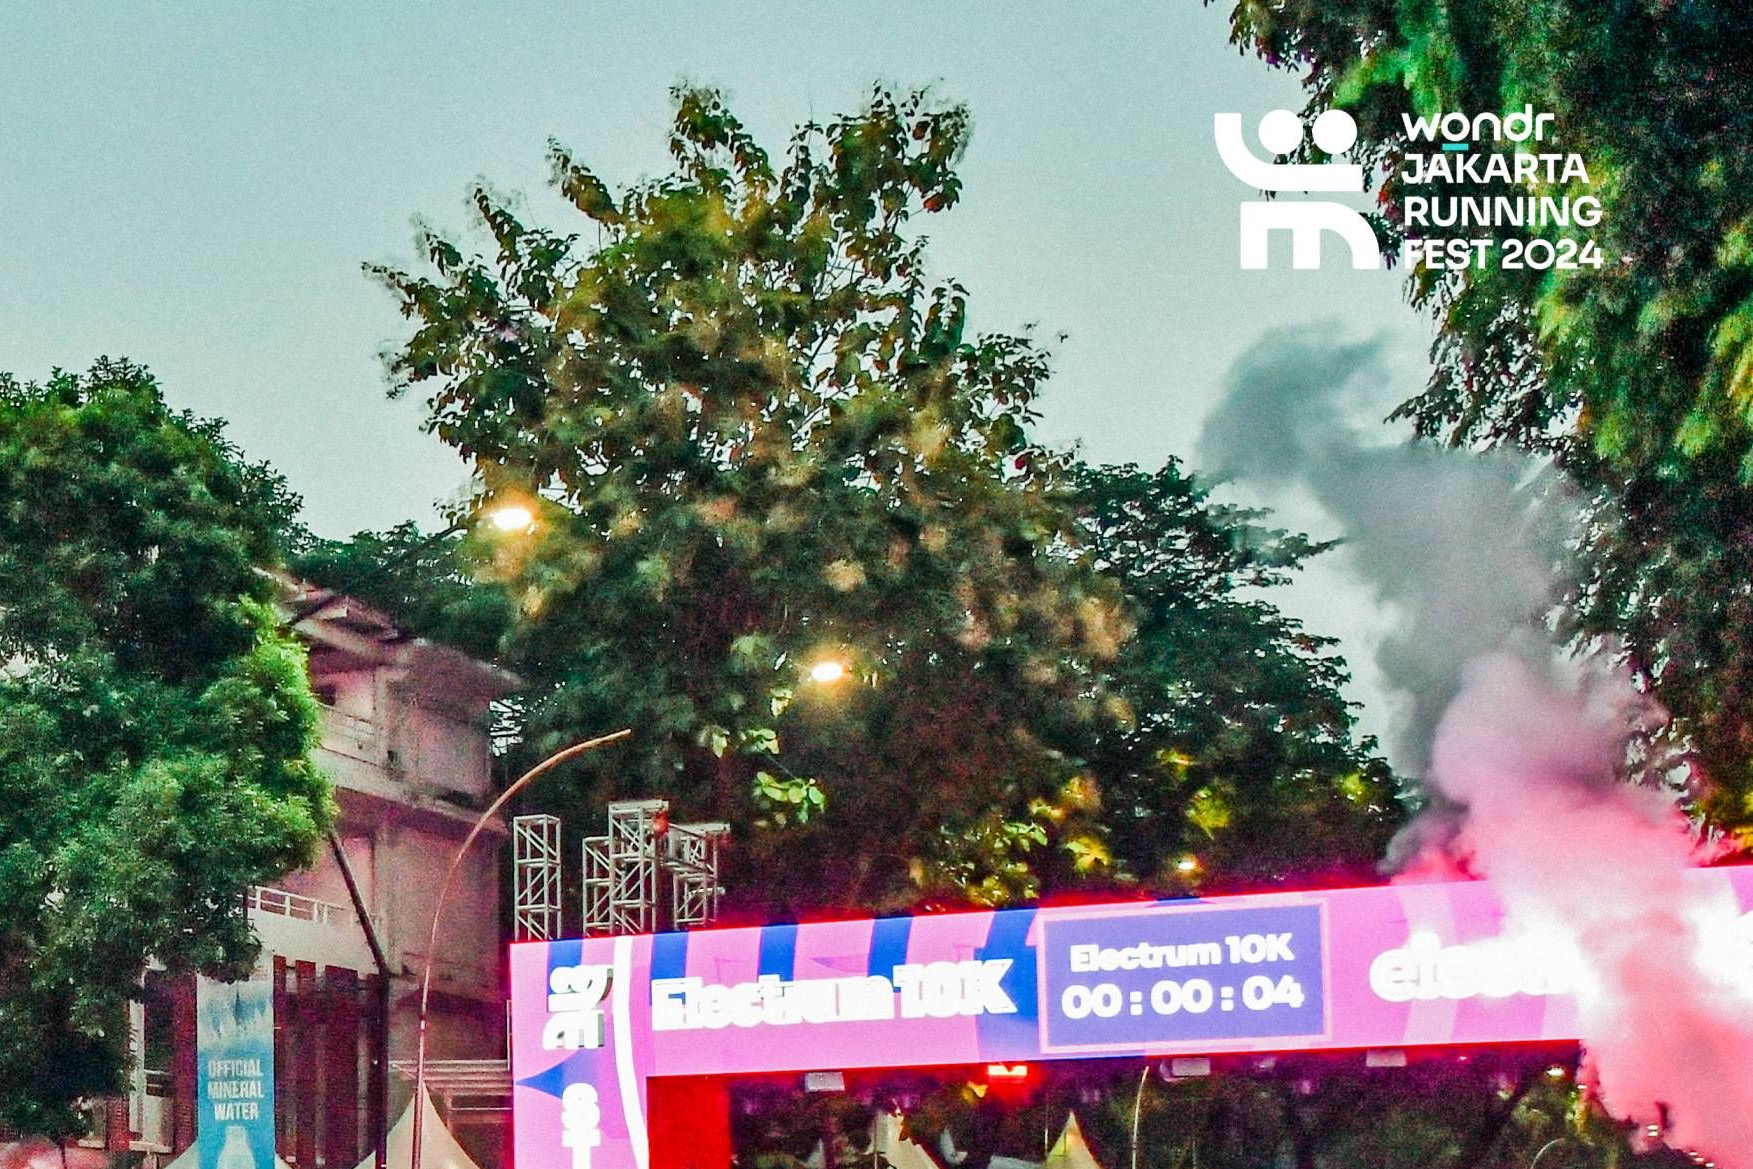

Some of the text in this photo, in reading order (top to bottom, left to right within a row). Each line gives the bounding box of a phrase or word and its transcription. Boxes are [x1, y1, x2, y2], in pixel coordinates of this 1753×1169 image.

[1069, 932, 1295, 973] Electrum 10K
[651, 958, 1018, 1031] Electrum 10K
[208, 1059, 263, 1078] OFFICIAL
[207, 1080, 264, 1098] MINERAL
[213, 1102, 260, 1121] WATER
